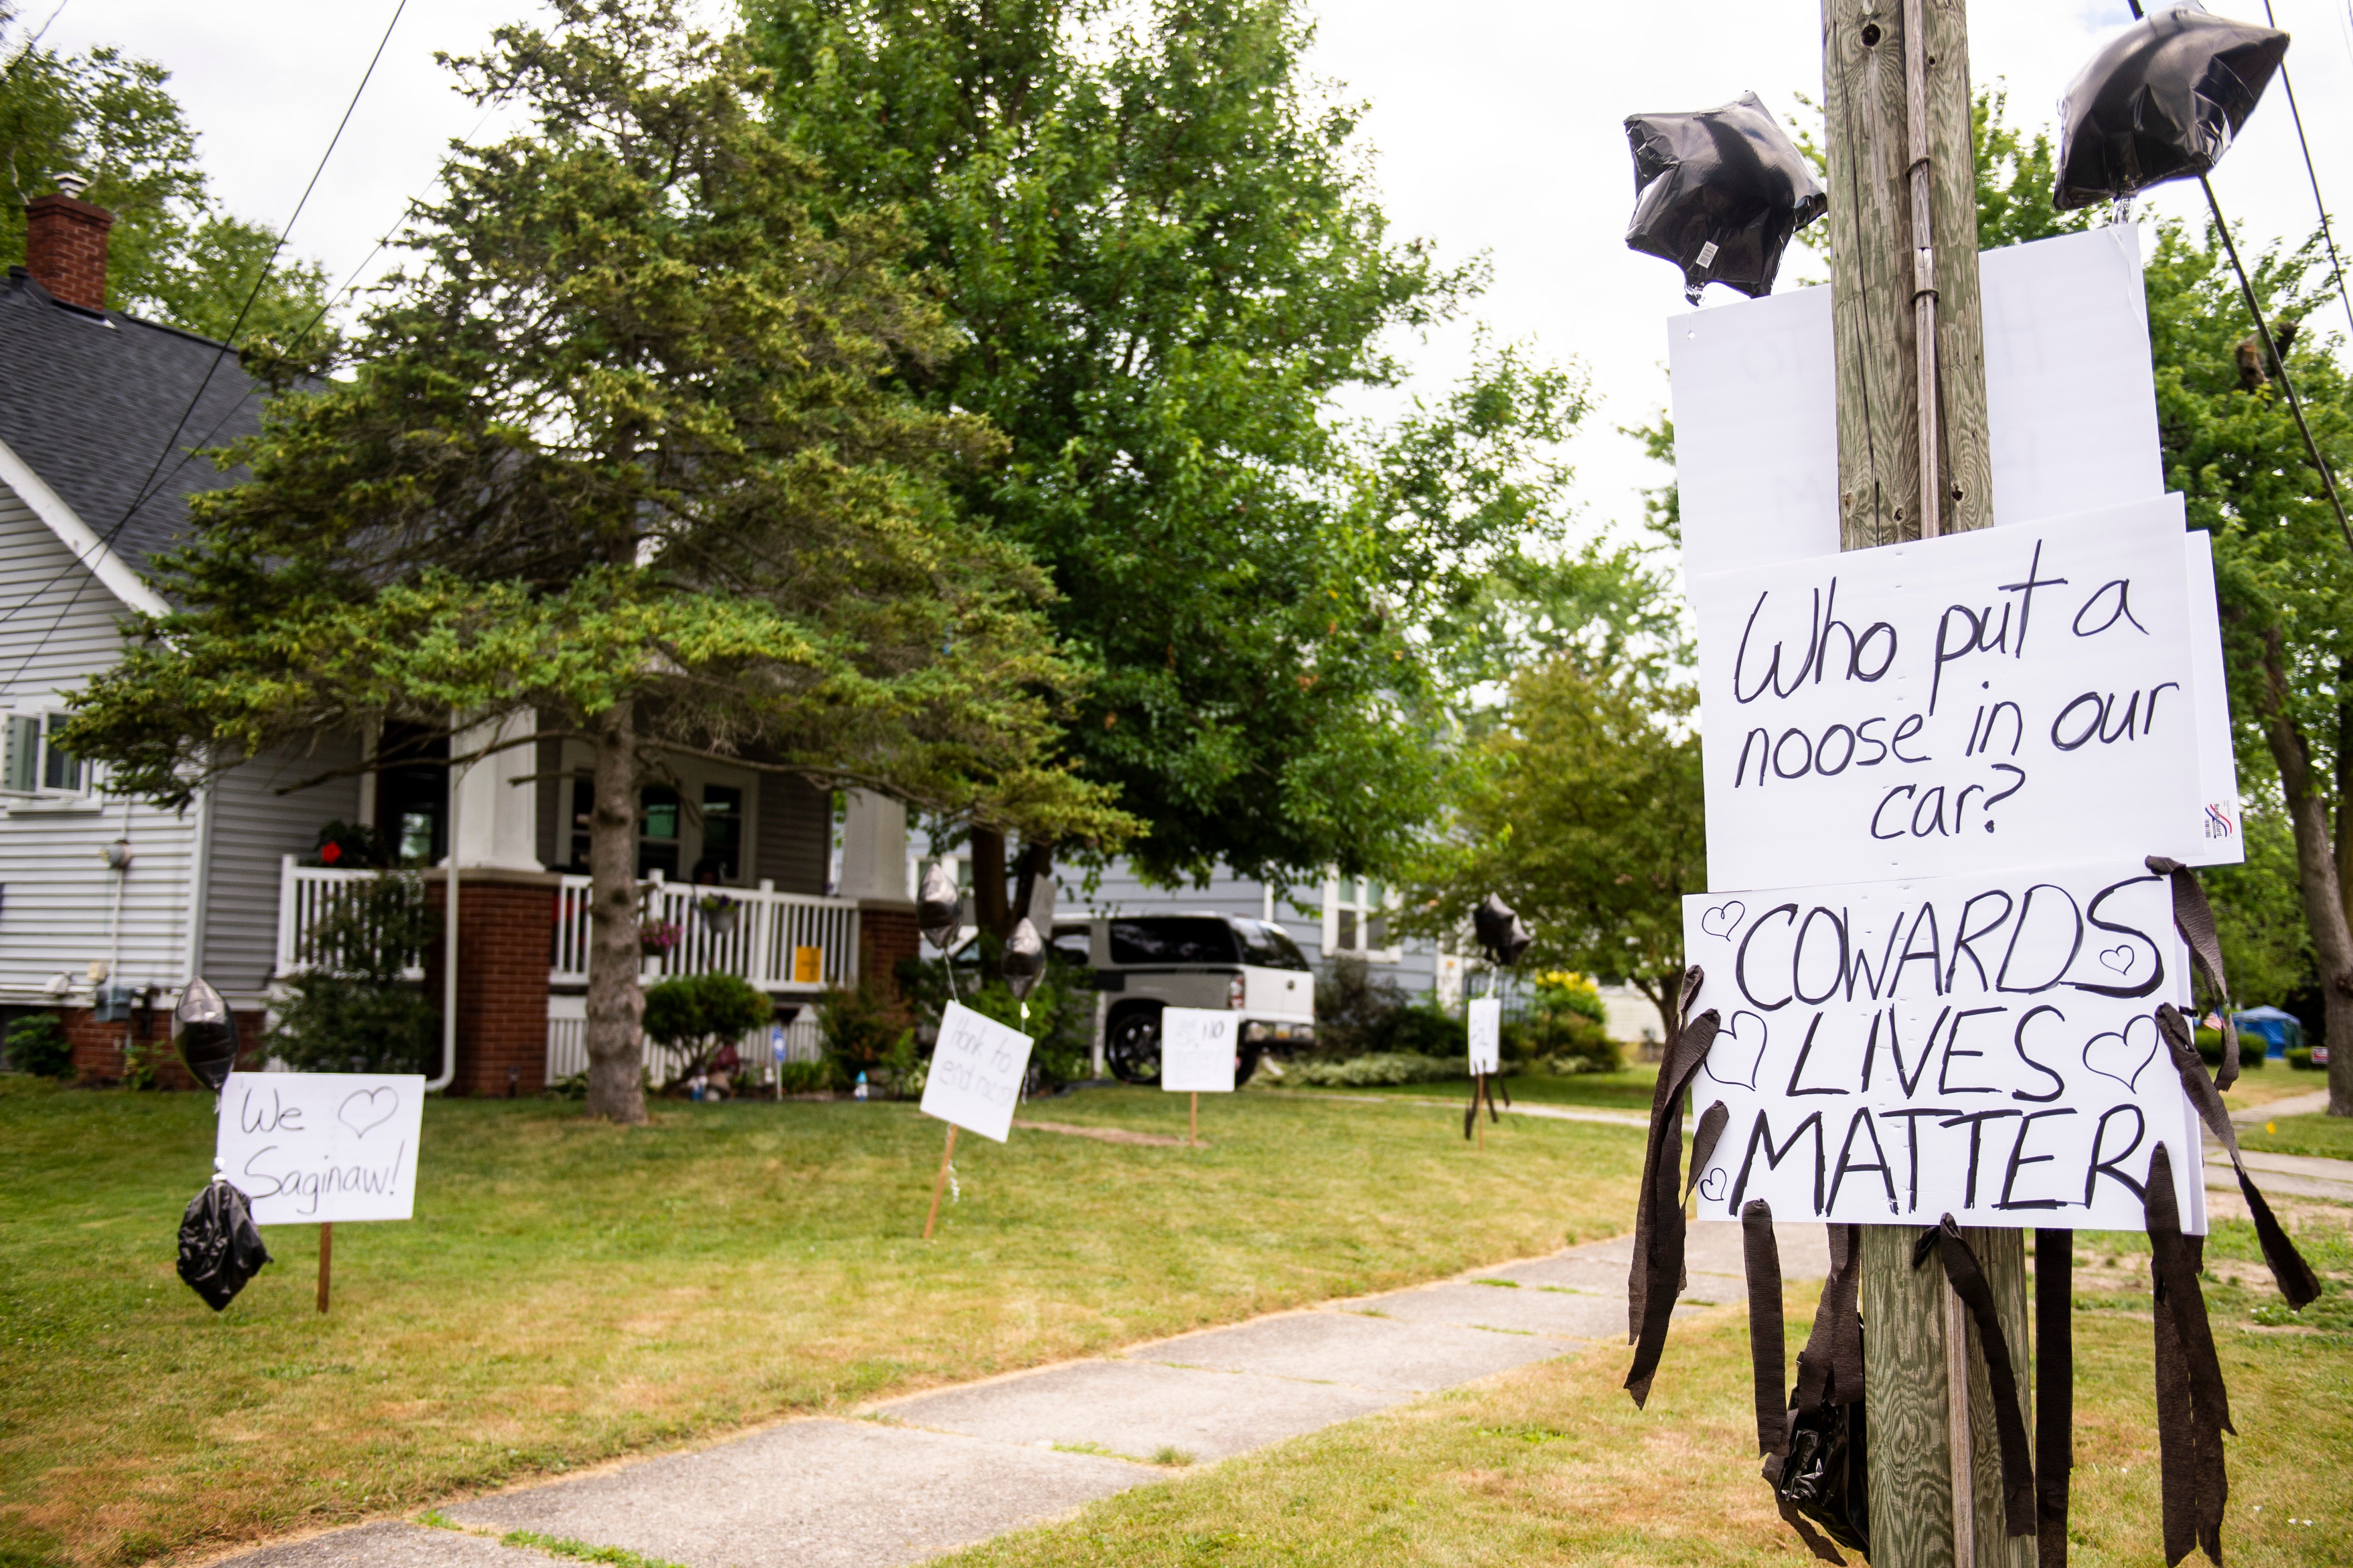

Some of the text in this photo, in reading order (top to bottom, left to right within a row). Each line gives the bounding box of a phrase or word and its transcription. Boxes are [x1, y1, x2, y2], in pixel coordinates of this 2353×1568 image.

[1734, 540, 2149, 716] Who put a
[1735, 681, 2179, 788] noose in our
[1871, 763, 2025, 839] car?
[1735, 876, 2165, 1011] COWARDS
[1786, 1004, 2065, 1102] LIVES
[242, 1088, 305, 1134] We
[1728, 1103, 2146, 1217] MATTER
[244, 1140, 405, 1215] Saginaw!
